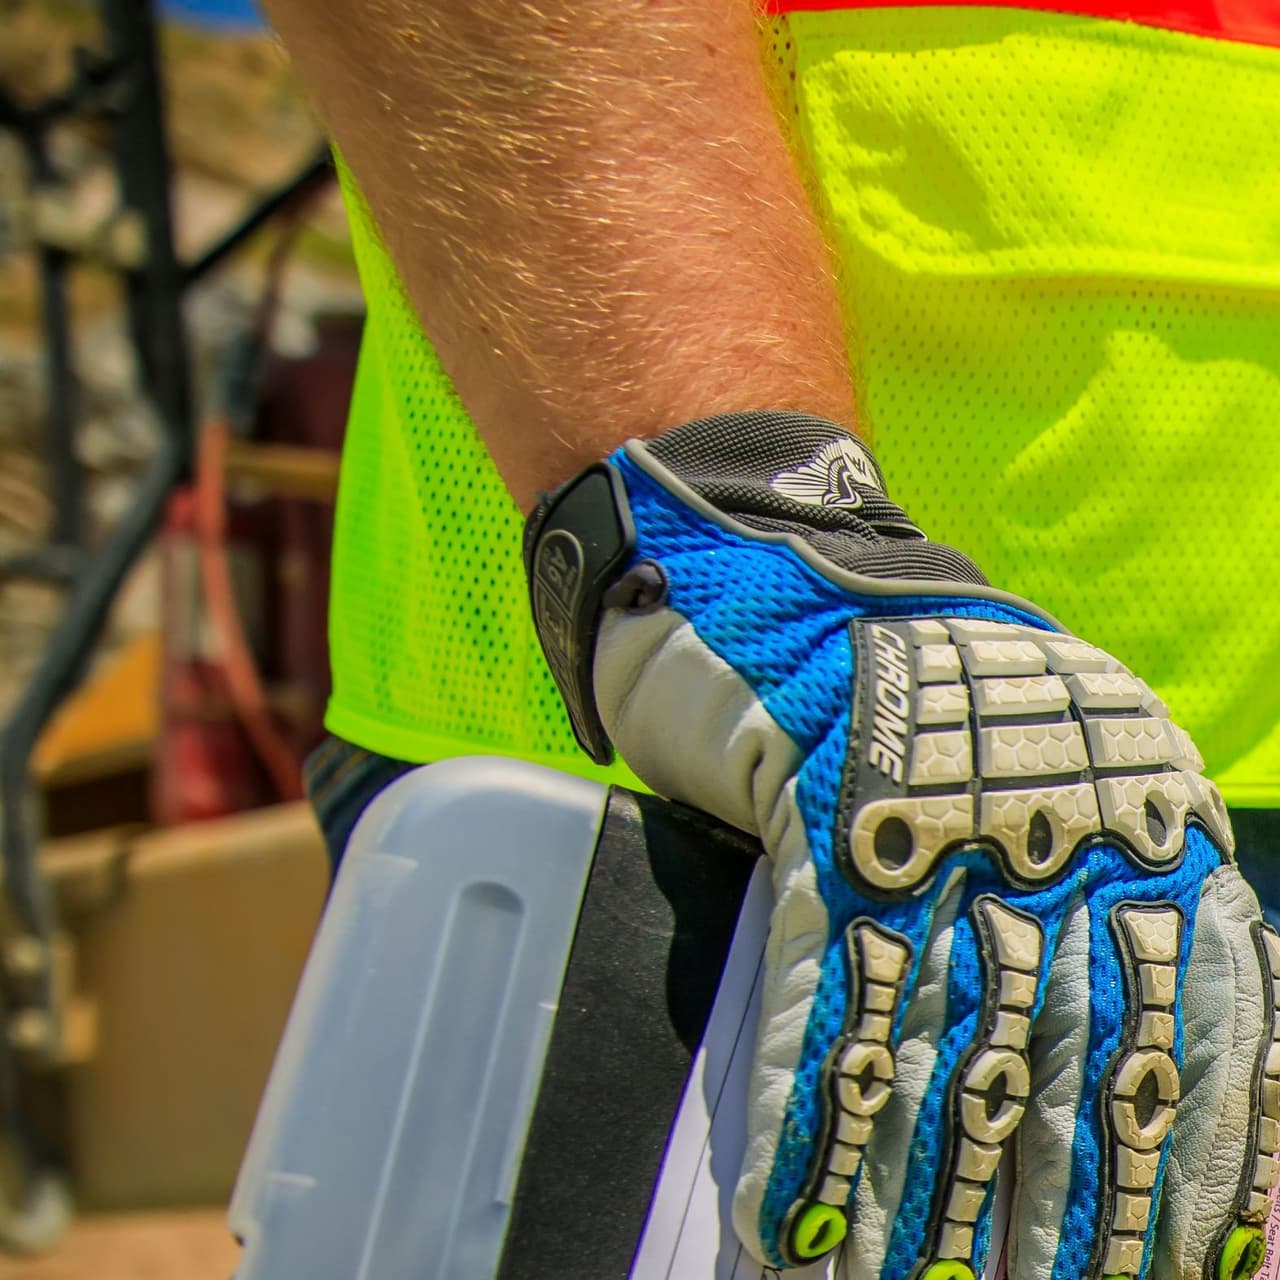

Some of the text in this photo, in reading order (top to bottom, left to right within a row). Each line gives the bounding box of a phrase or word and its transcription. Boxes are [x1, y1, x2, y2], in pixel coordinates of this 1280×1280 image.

[868, 624, 910, 784] CHROME
[1267, 1223, 1278, 1245] Seat
[1262, 1248, 1274, 1268] Belt
